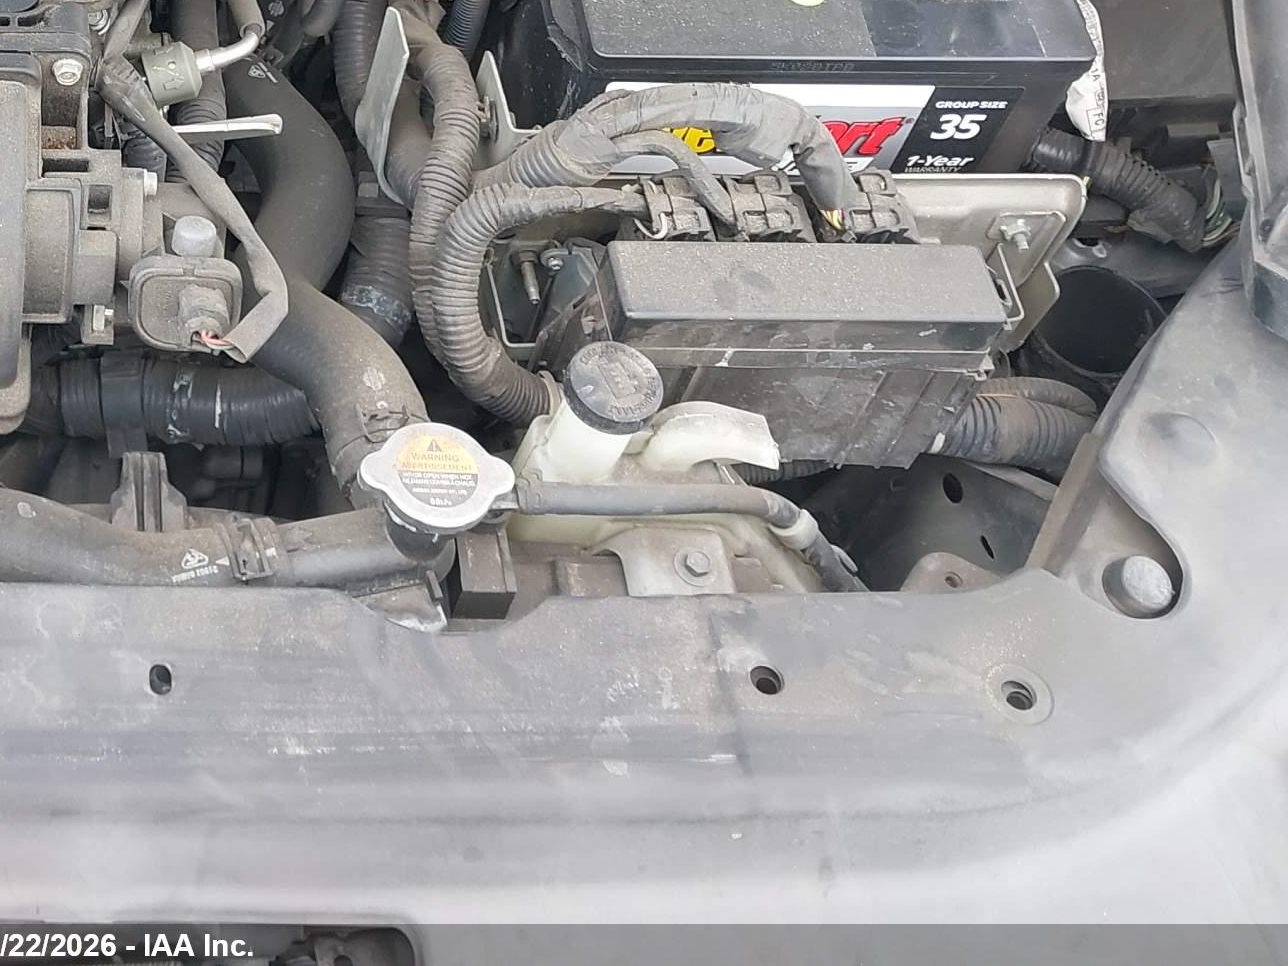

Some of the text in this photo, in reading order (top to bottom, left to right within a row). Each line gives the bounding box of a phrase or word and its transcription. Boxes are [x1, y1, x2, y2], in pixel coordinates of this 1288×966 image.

[935, 101, 1008, 110] GROUP SIZE
[930, 114, 988, 140] 35
[906, 154, 974, 168] 1-Year
[904, 166, 962, 174] WARRANTY
[411, 452, 460, 463] WARNING
